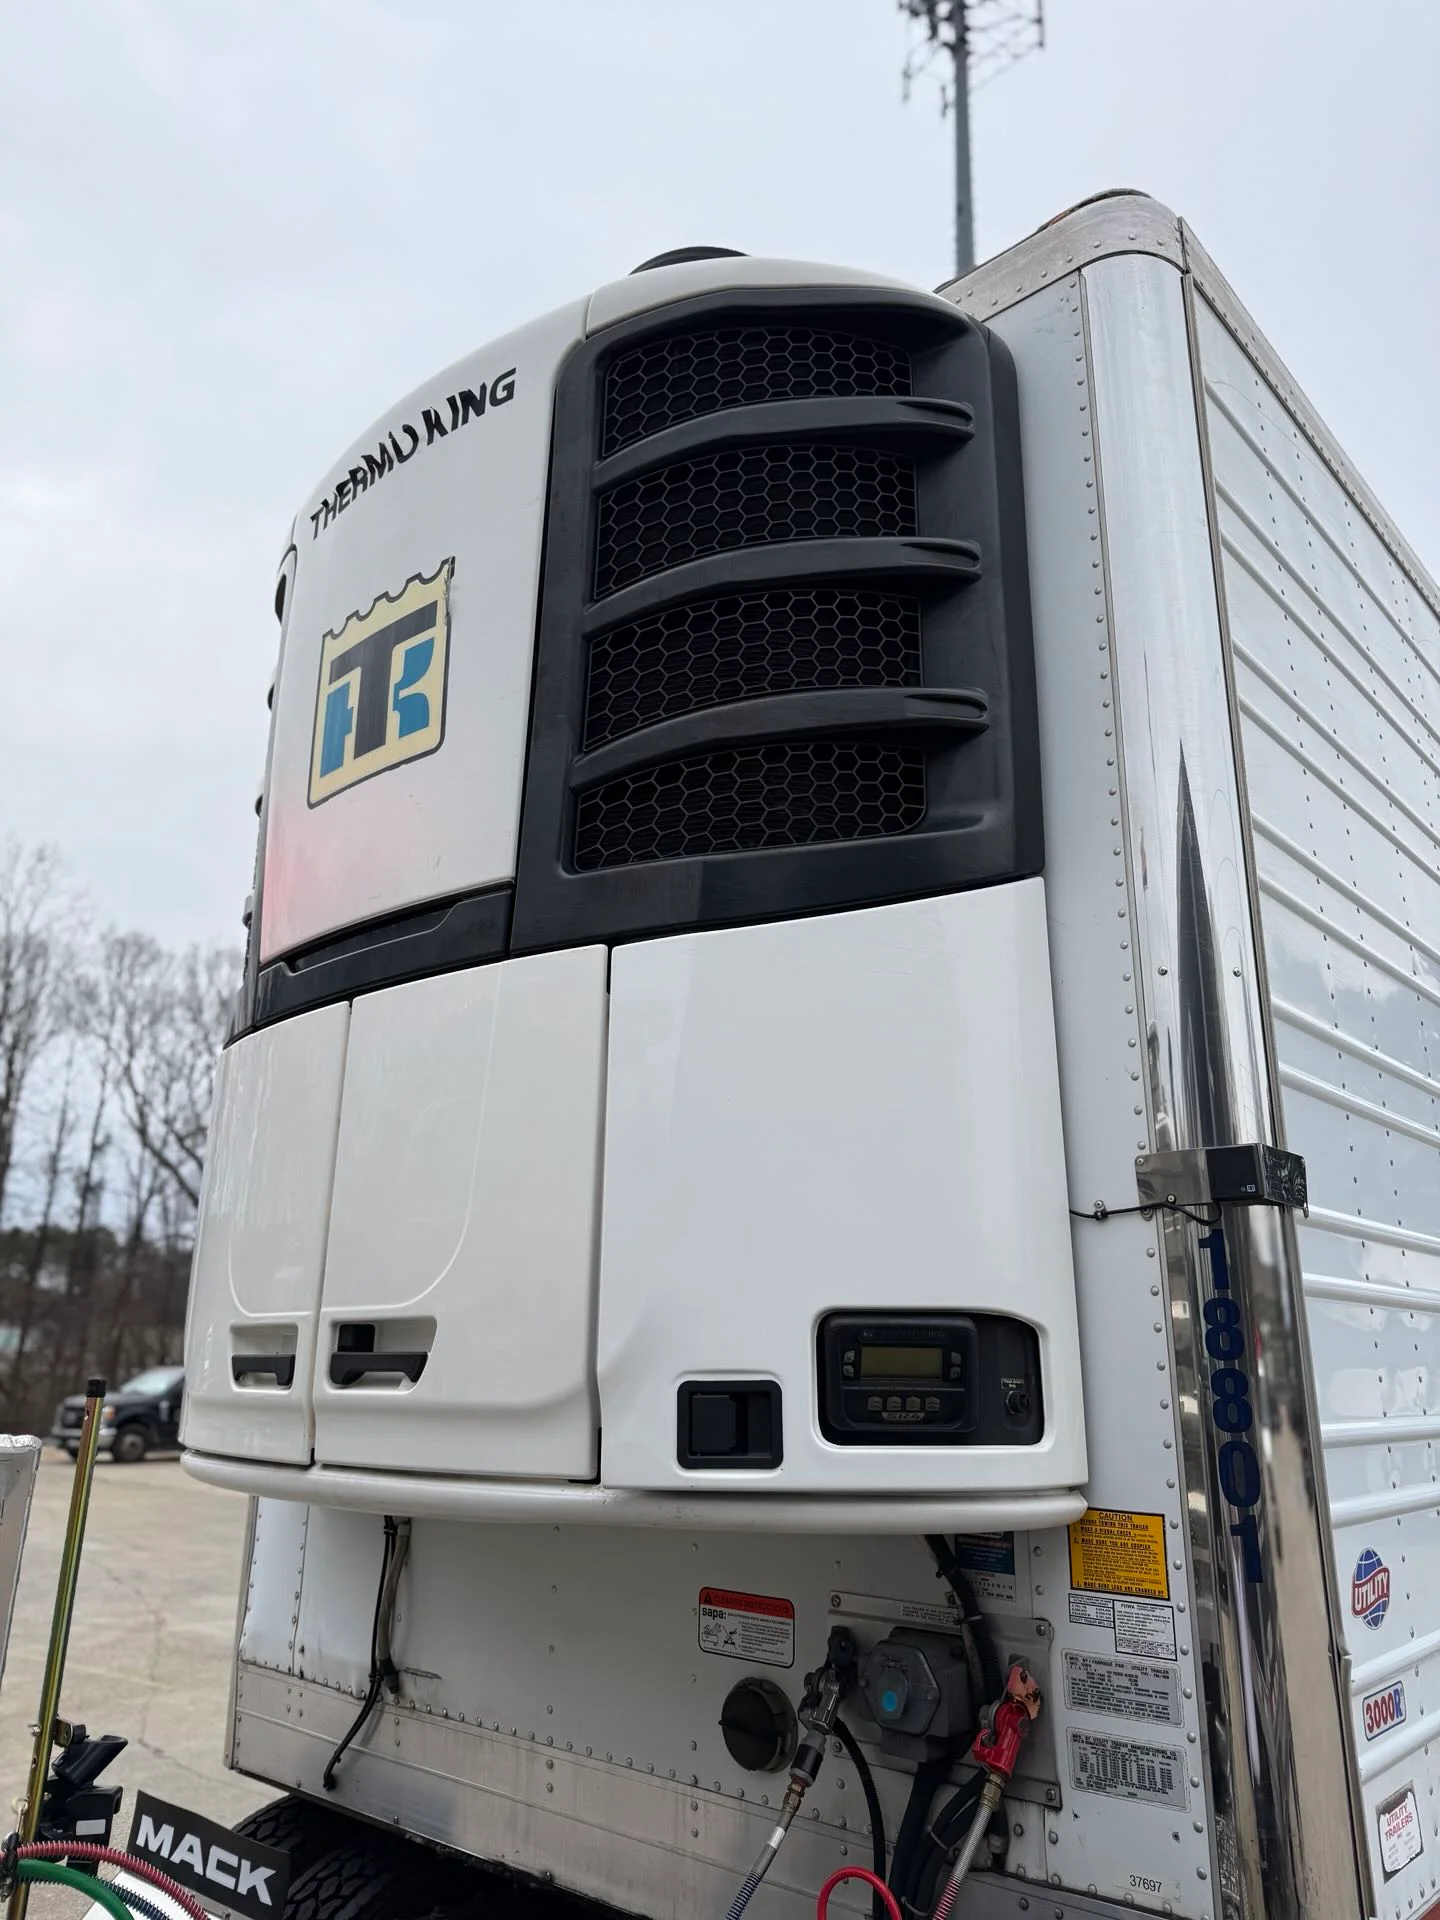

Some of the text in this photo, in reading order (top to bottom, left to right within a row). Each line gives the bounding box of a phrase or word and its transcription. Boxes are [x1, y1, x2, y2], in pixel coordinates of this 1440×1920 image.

[310, 367, 516, 541] THERMO KING
[1199, 1228, 1263, 1583] 18801
[1098, 1512, 1133, 1522] CAUTION
[1354, 1571, 1388, 1611] UTILITY
[1366, 1688, 1403, 1733] 3000R
[1385, 1812, 1413, 1840] TRAILERS
[1386, 1802, 1408, 1827] UTILITY
[136, 1814, 276, 1906] MACK
[1129, 1874, 1162, 1893] 37697
